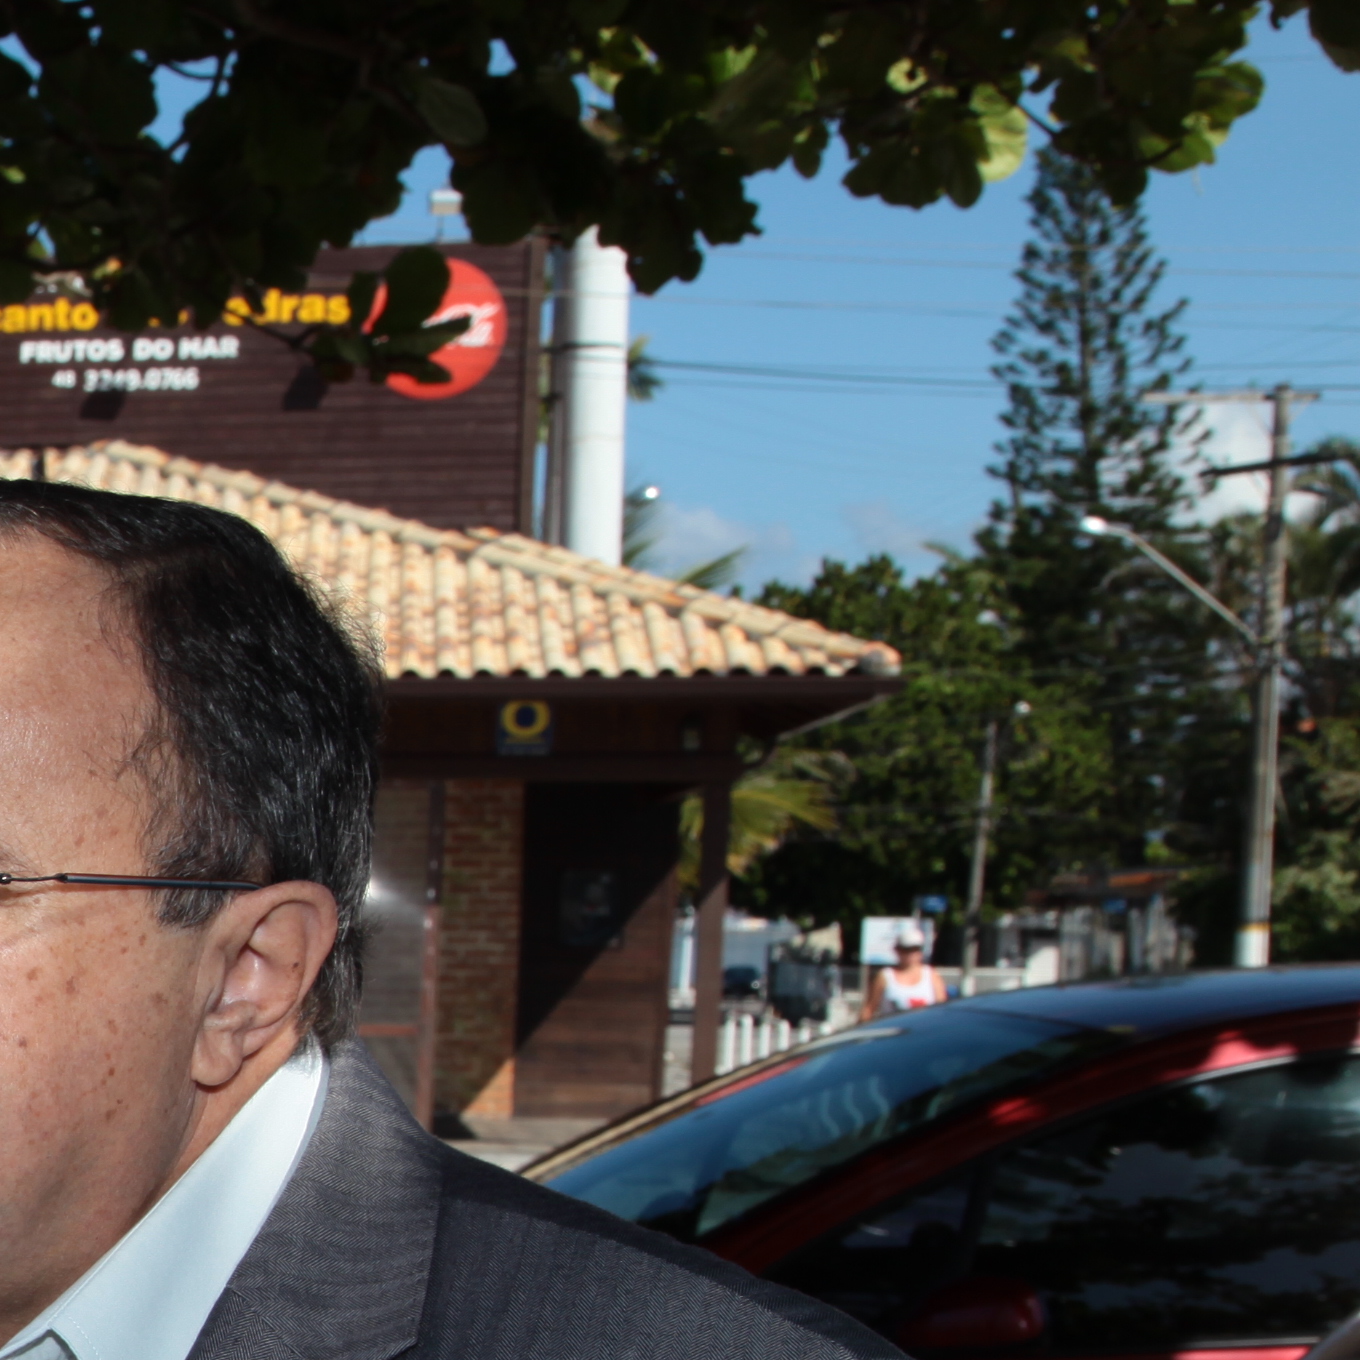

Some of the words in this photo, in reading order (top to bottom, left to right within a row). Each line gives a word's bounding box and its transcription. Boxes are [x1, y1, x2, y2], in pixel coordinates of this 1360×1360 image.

[218, 287, 352, 326] edras
[19, 338, 125, 364] FRUTOS
[132, 337, 175, 362] DO
[178, 335, 240, 360] MAR
